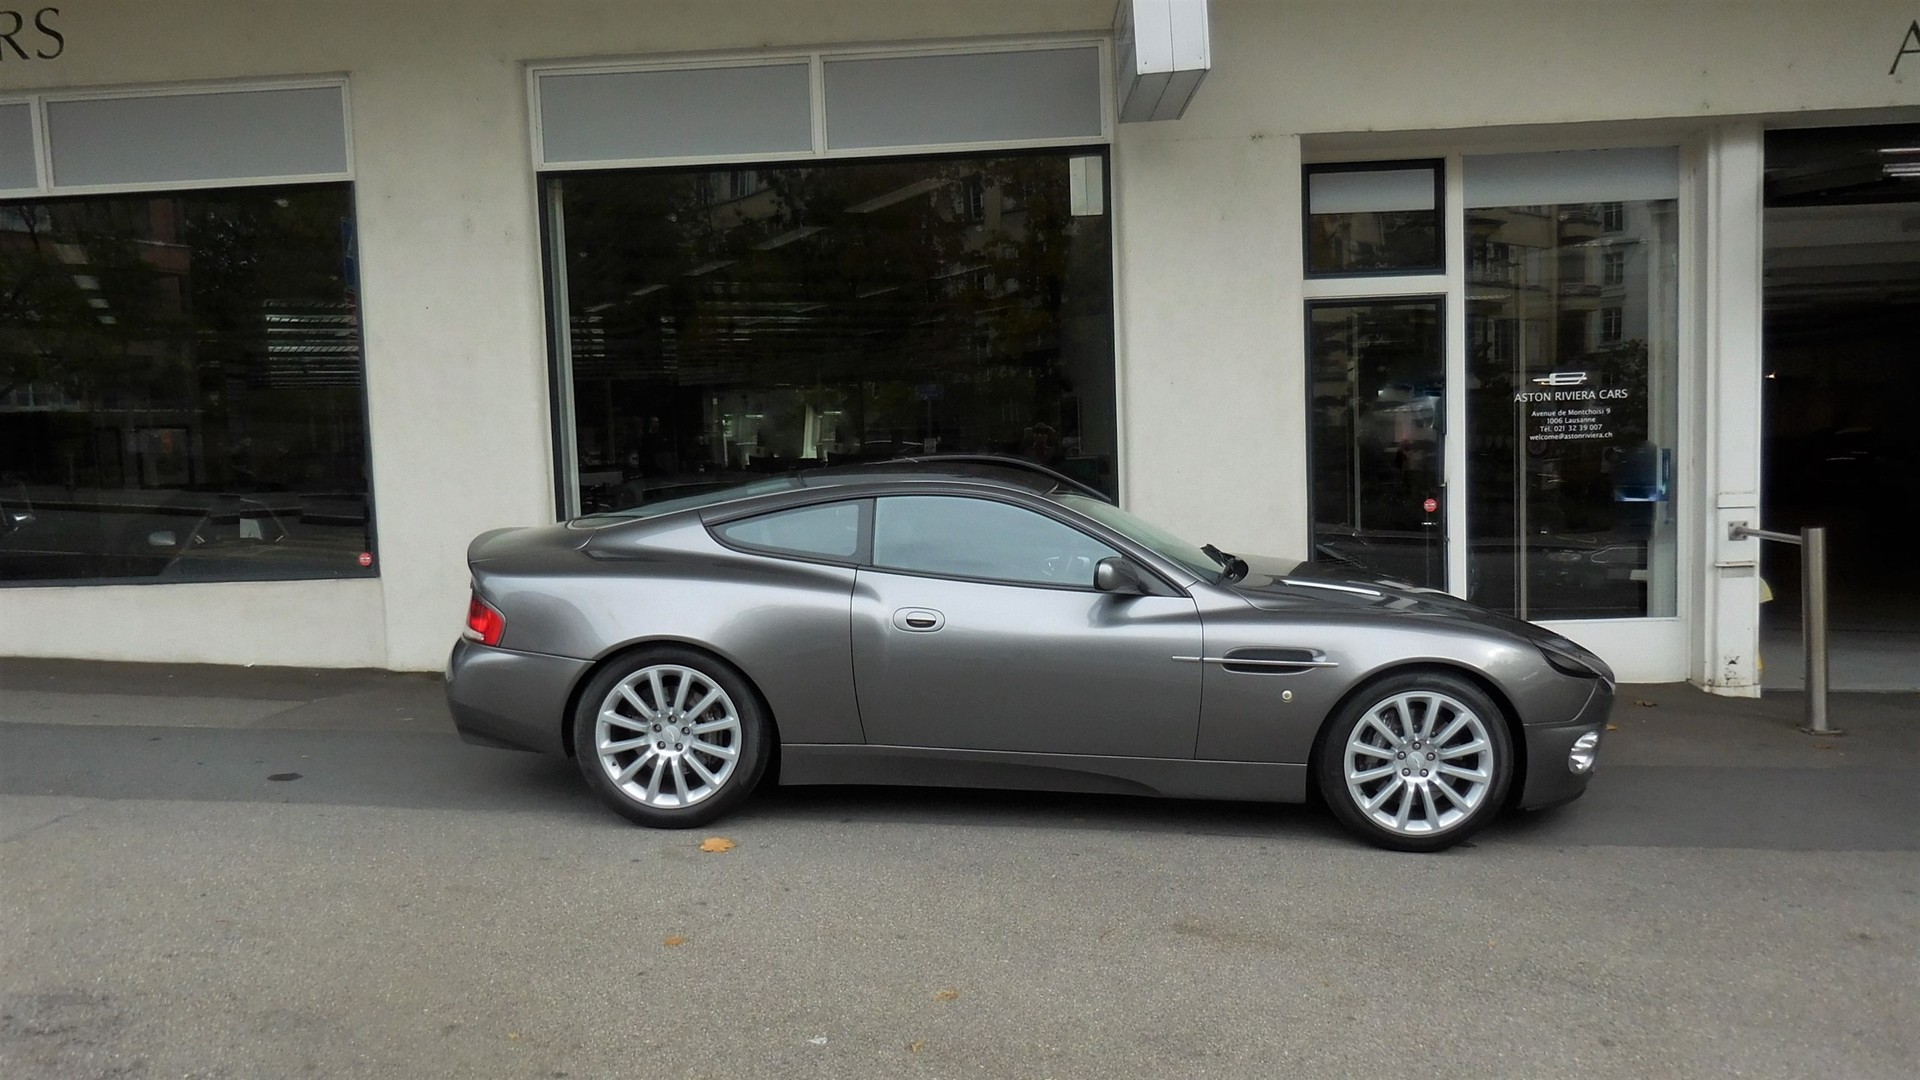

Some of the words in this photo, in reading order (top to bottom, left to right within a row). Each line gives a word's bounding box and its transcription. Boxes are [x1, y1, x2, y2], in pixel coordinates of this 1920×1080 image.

[1513, 392, 1551, 403] ASTON
[1555, 390, 1596, 401] RIVIERA
[1599, 389, 1628, 400] CARS
[1568, 408, 1604, 416] Montchoisi
[1605, 407, 1611, 415] 9
[1547, 417, 1563, 425] 1006
[1589, 423, 1603, 431] 007
[1529, 431, 1613, 440] welcome@astonriviera.ch
